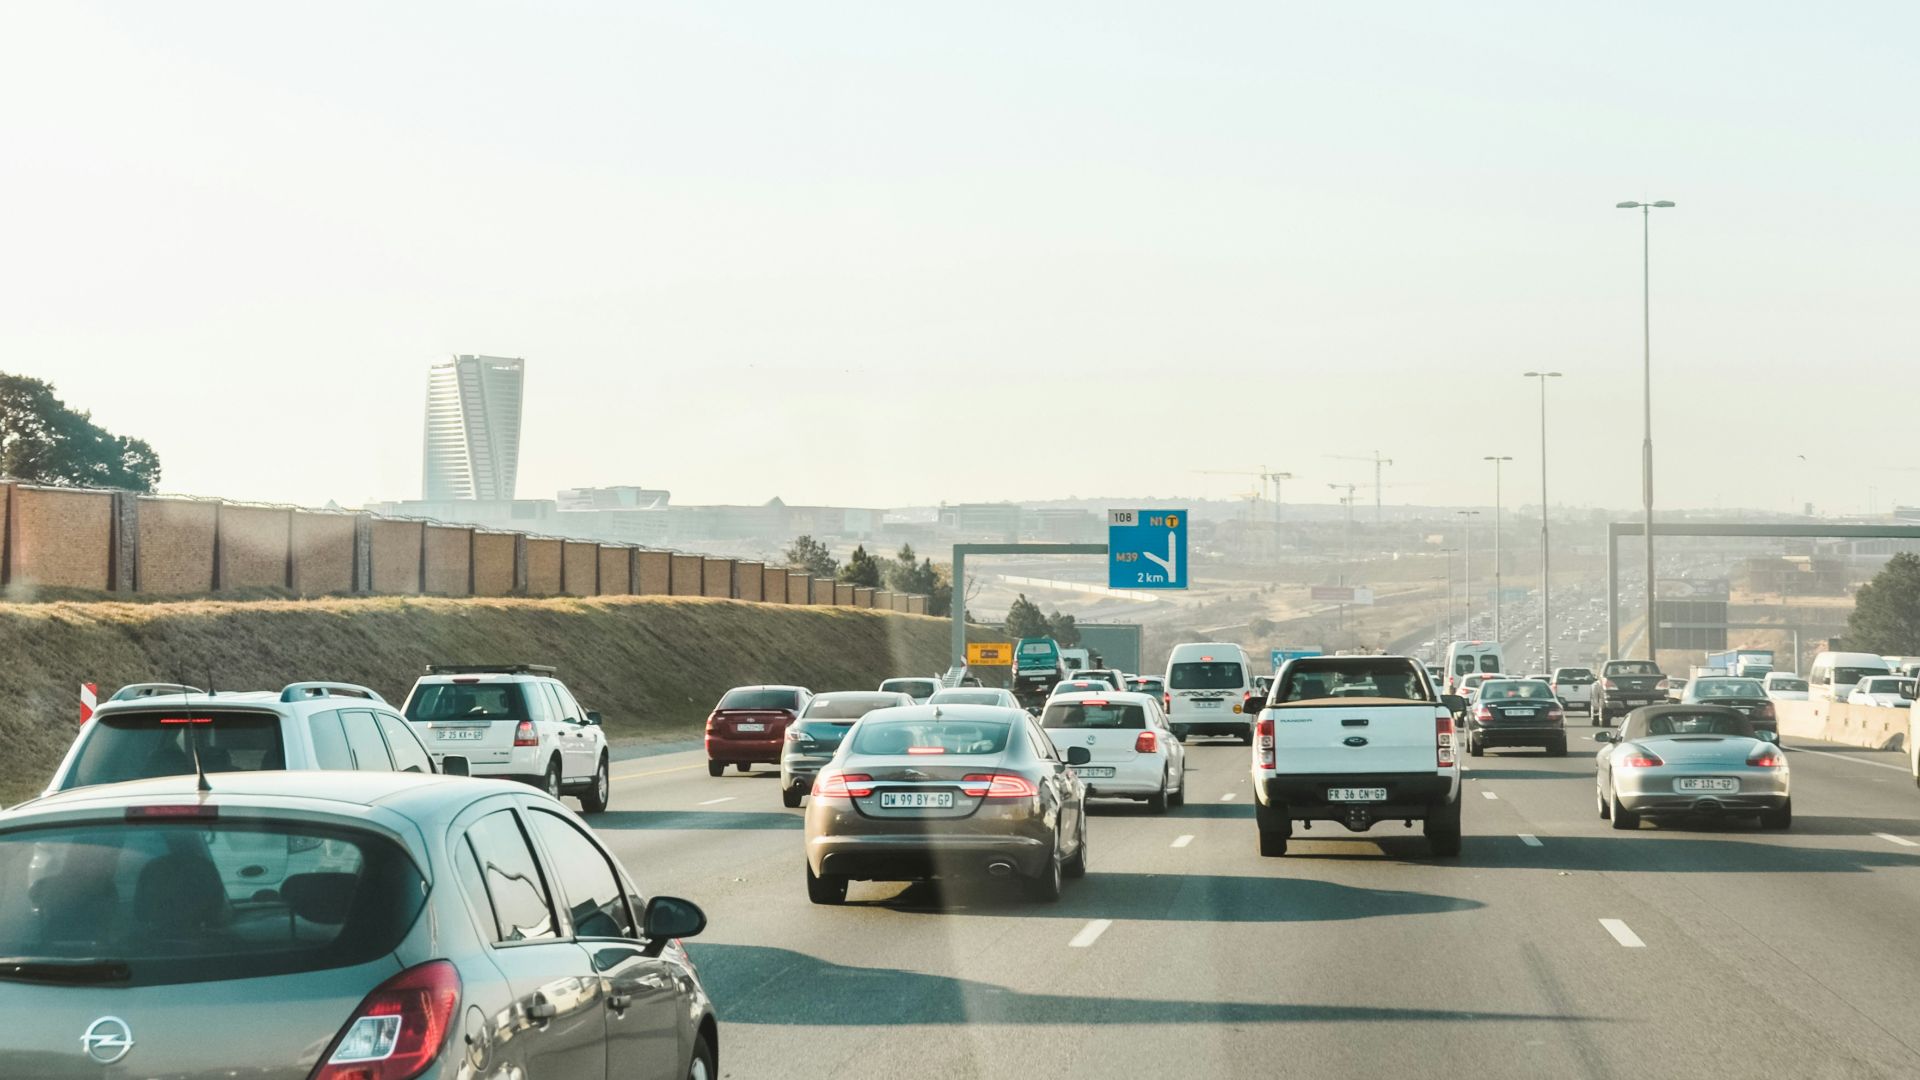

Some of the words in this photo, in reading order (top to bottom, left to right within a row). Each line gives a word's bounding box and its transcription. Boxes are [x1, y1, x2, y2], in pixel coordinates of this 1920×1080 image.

[1114, 512, 1132, 522] 108
[1150, 516, 1162, 526] N1
[1167, 517, 1177, 527] T
[1116, 552, 1138, 562] M39
[1137, 572, 1144, 583] 2
[1146, 572, 1164, 583] km
[1702, 779, 1714, 789] 131
[1722, 779, 1731, 788] GP
[884, 794, 896, 806] DW
[900, 794, 912, 806] 99
[917, 794, 929, 805] BY
[937, 794, 950, 806] GP
[1329, 789, 1340, 800] FR
[1344, 789, 1355, 800] 36
[1359, 789, 1370, 800] CN
[1375, 789, 1385, 800] GP
